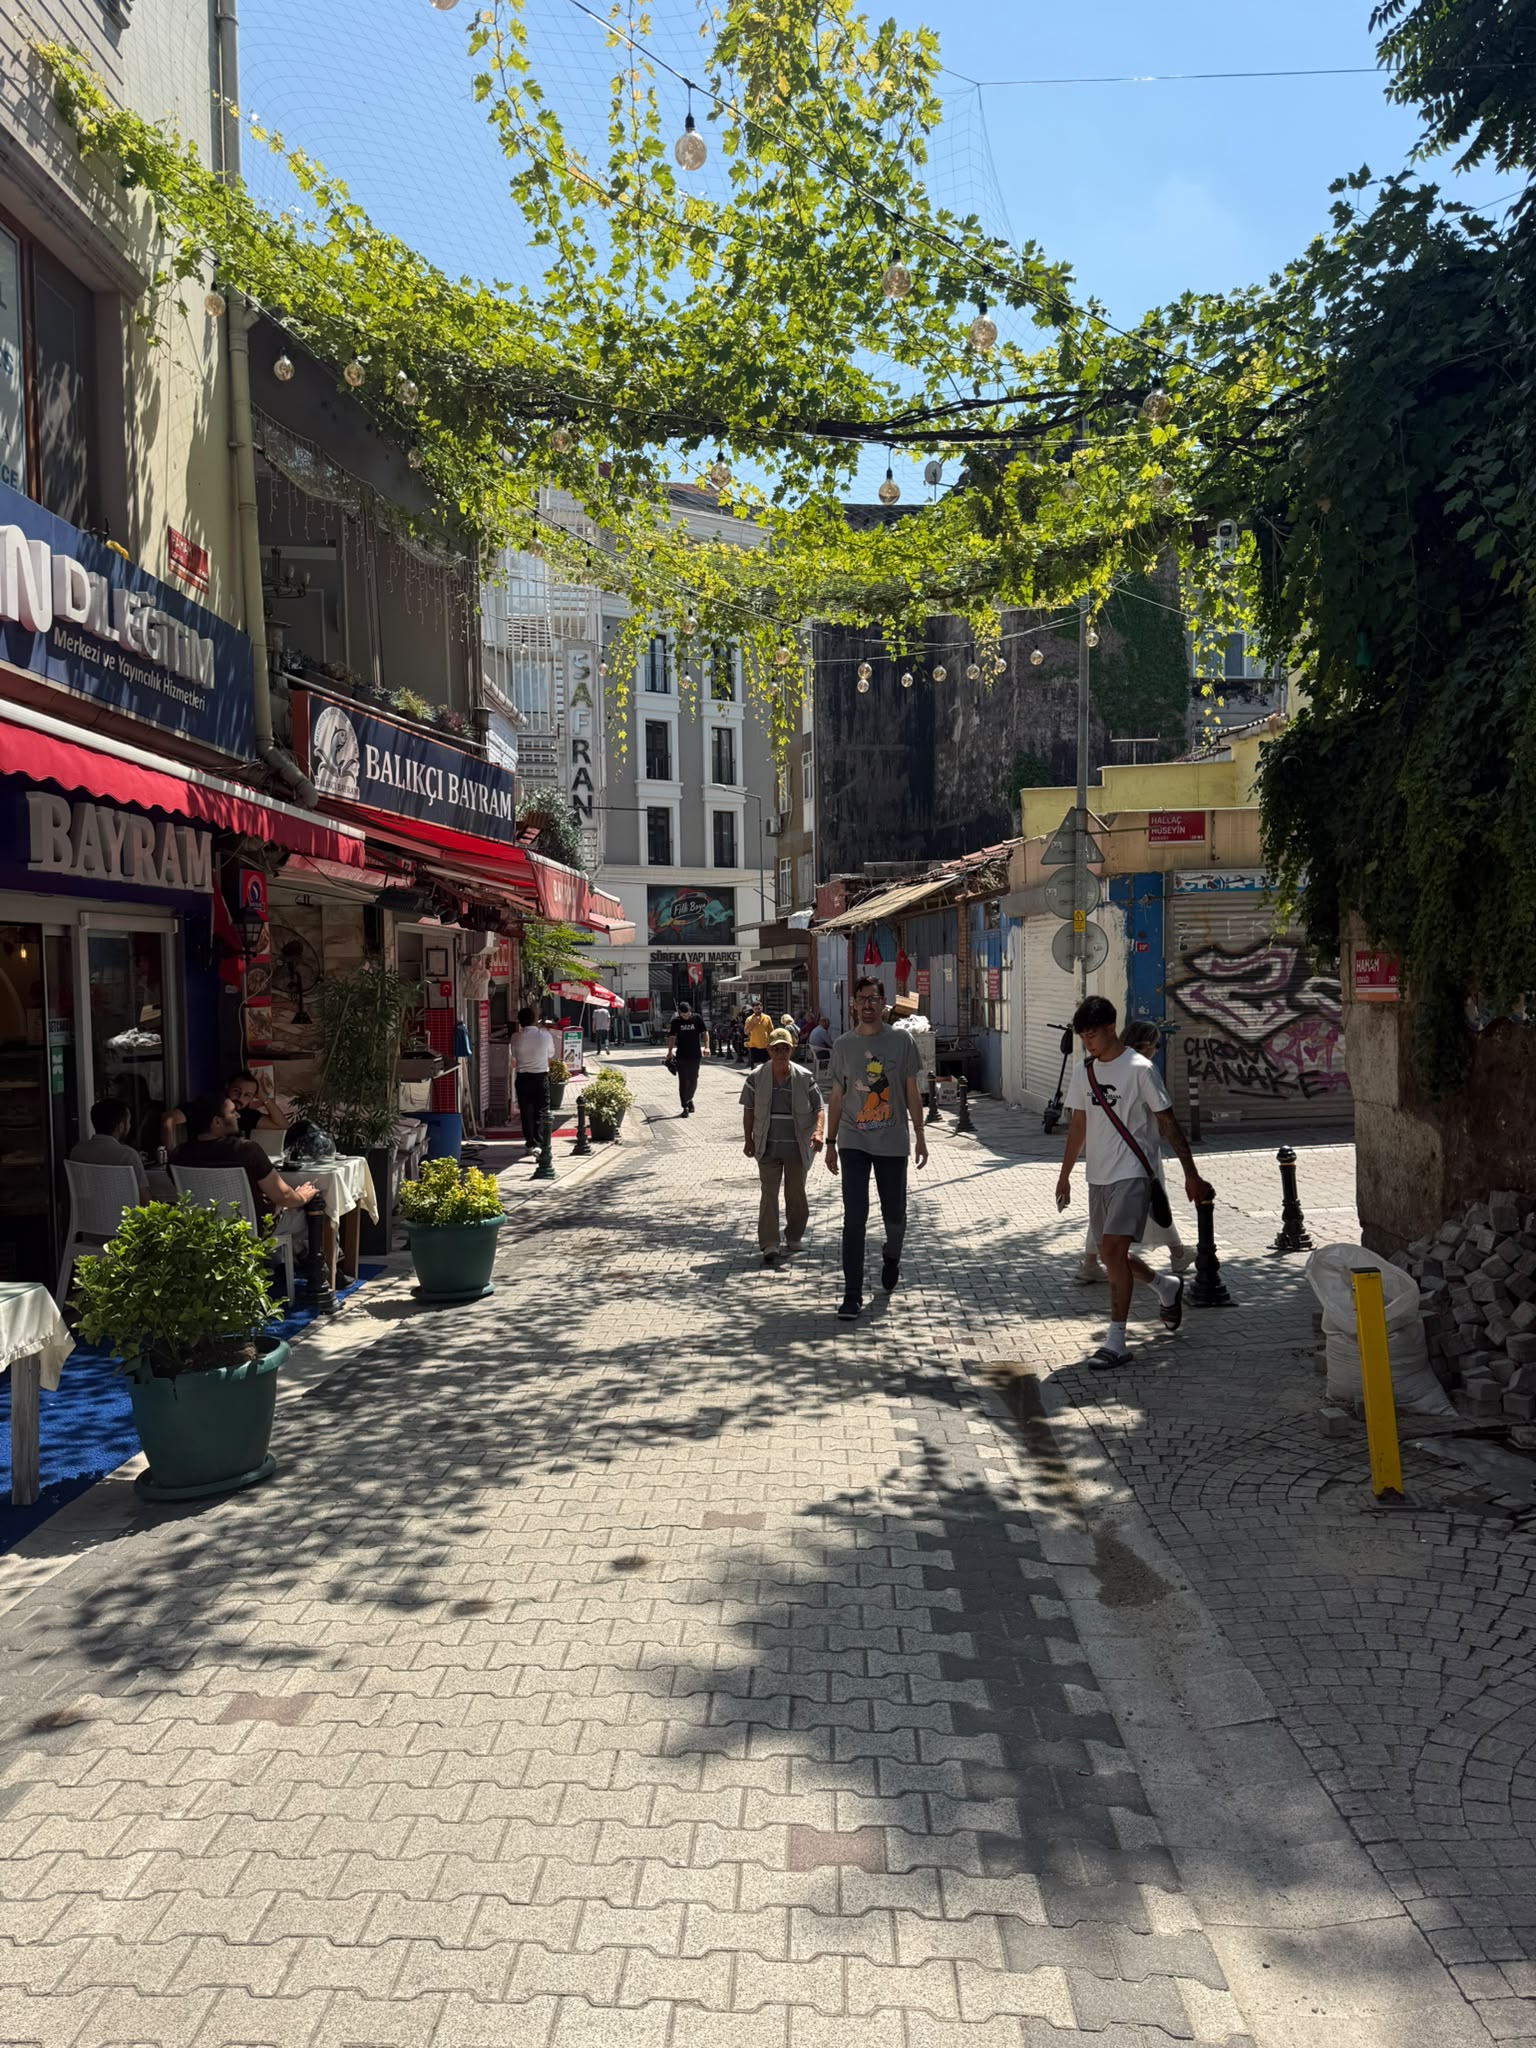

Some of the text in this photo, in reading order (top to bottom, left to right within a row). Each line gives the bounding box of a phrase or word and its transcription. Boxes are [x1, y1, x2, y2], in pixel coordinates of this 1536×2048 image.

[54, 627, 206, 711] Merkezi ve Yayıncılık Hizmetleri
[570, 653, 594, 826] SAFRAN
[365, 744, 512, 821] BALIKÇI BAYRAM
[1151, 816, 1182, 825] HALLAÇ
[26, 791, 214, 893] BAYRAM
[1151, 825, 1186, 835] HÜSEYİN
[650, 950, 742, 962] SÜREKA YAPI MARKET
